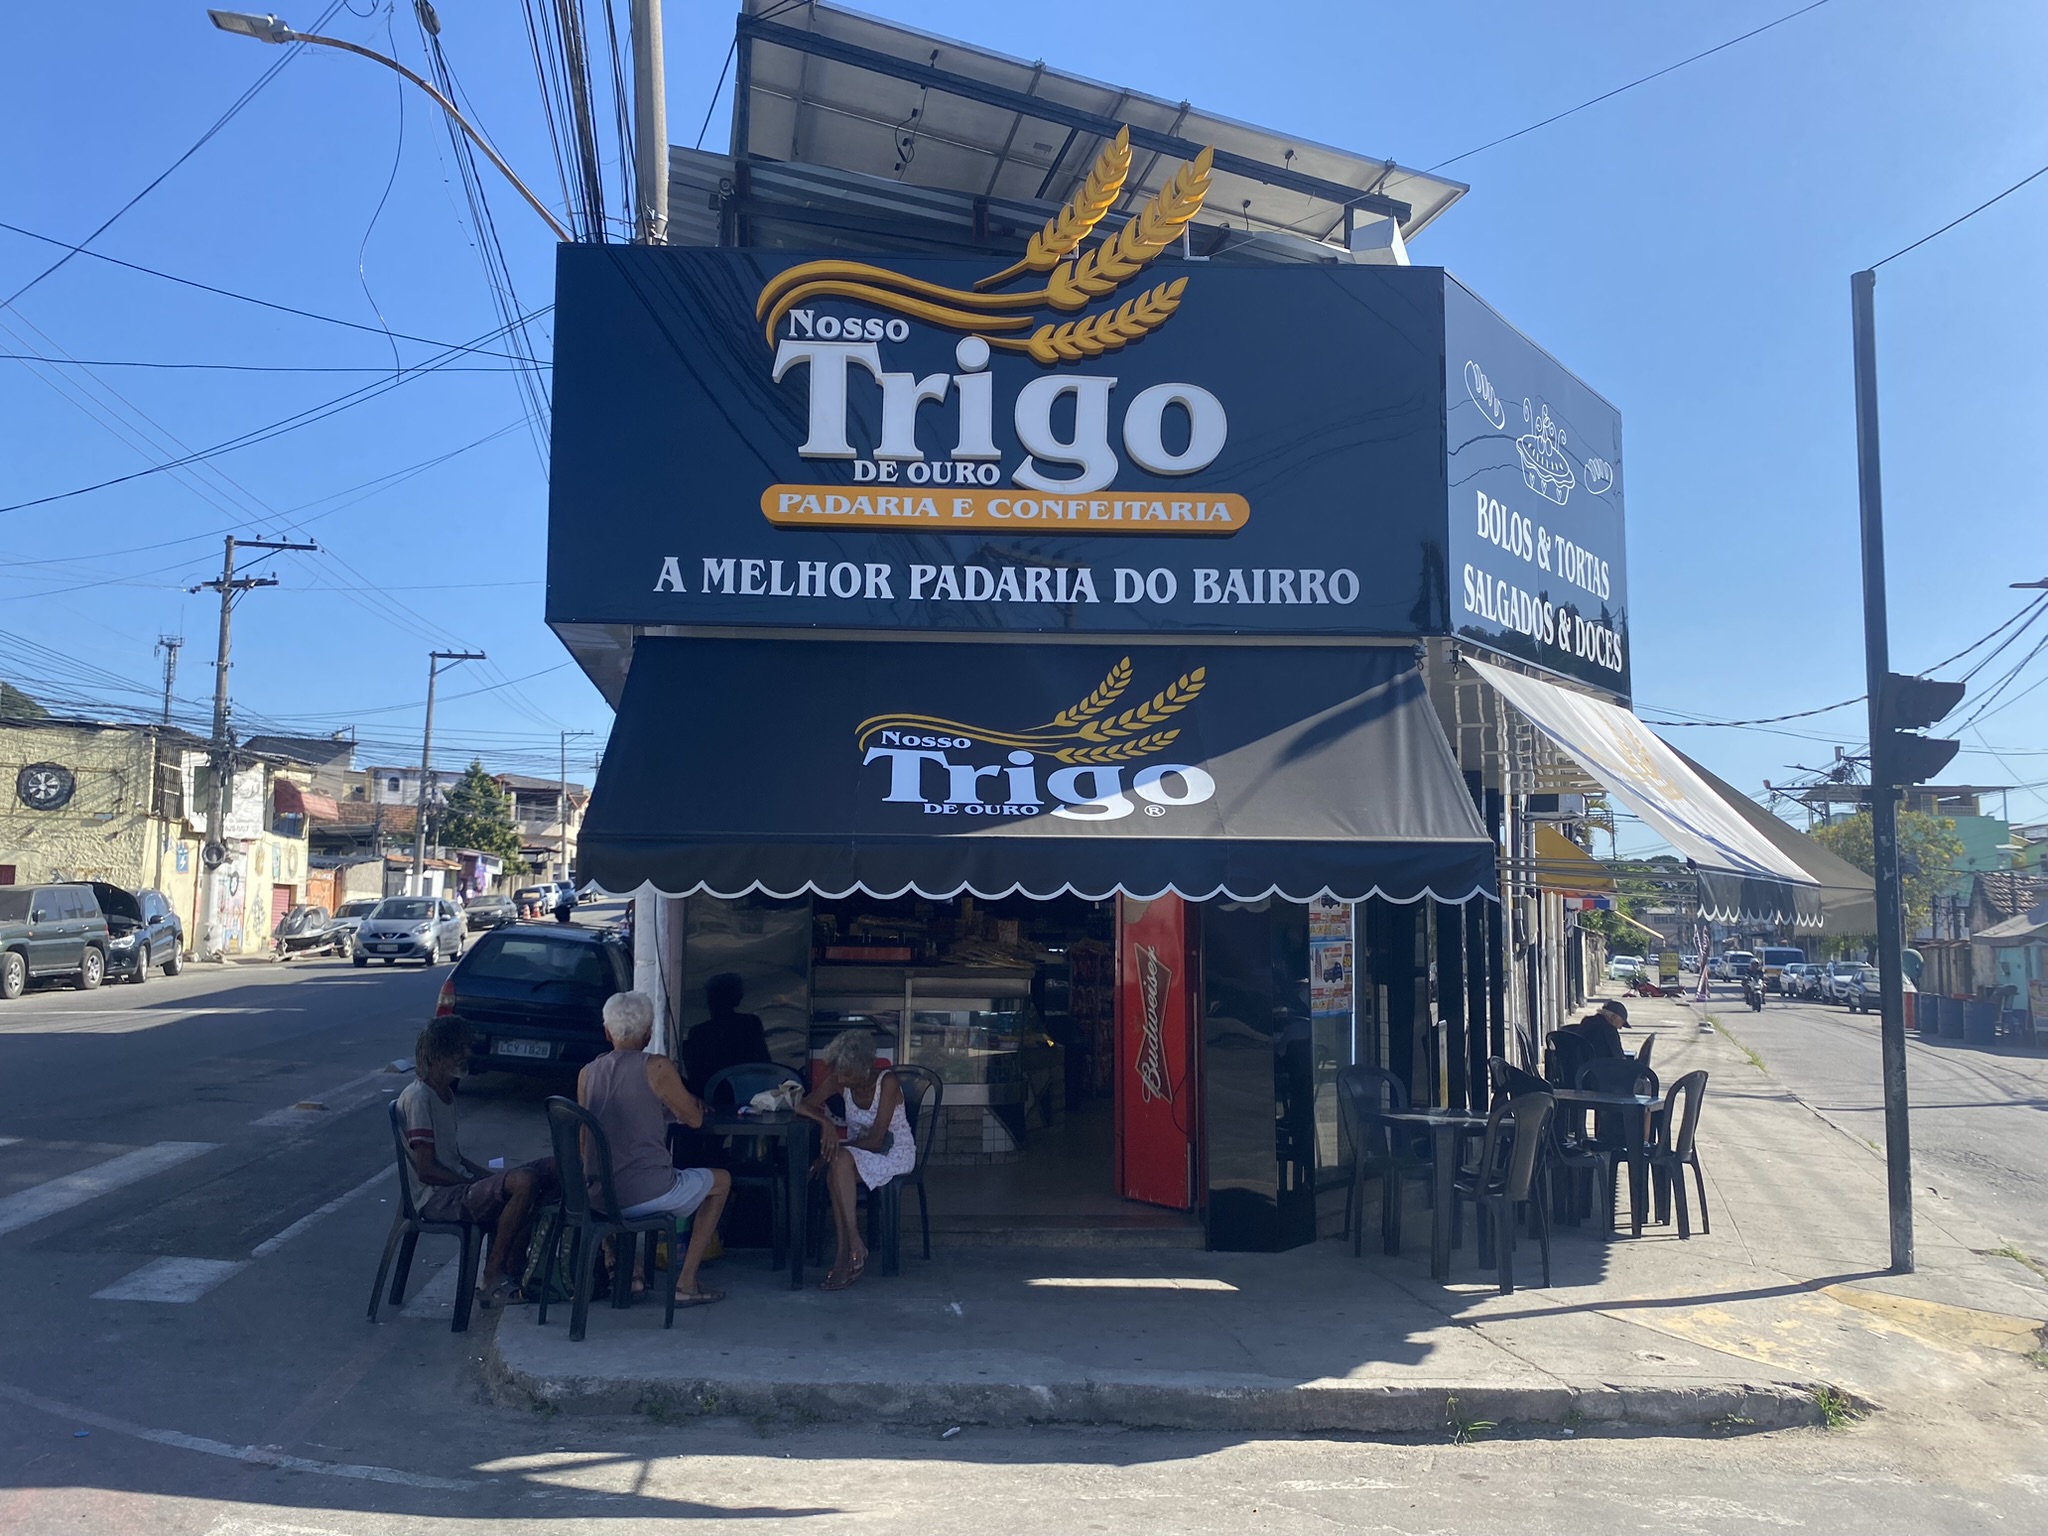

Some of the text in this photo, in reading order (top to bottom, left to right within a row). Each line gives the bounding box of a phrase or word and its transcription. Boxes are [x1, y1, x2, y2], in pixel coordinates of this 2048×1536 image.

[772, 336, 1228, 495] Trigo
[778, 493, 1232, 522] PADARIA E CONFEITARIA
[853, 459, 1001, 486] DE OURO
[653, 556, 1361, 606] A MELHOR PADARIA DO BAIRRO
[1476, 489, 1610, 601] BOLOS & TORTAS
[1463, 562, 1622, 673] SALGADOS & DOCES
[862, 746, 1216, 822] Trigo
[923, 803, 1040, 816] DE OURO
[1142, 944, 1162, 1104] Budweiser
